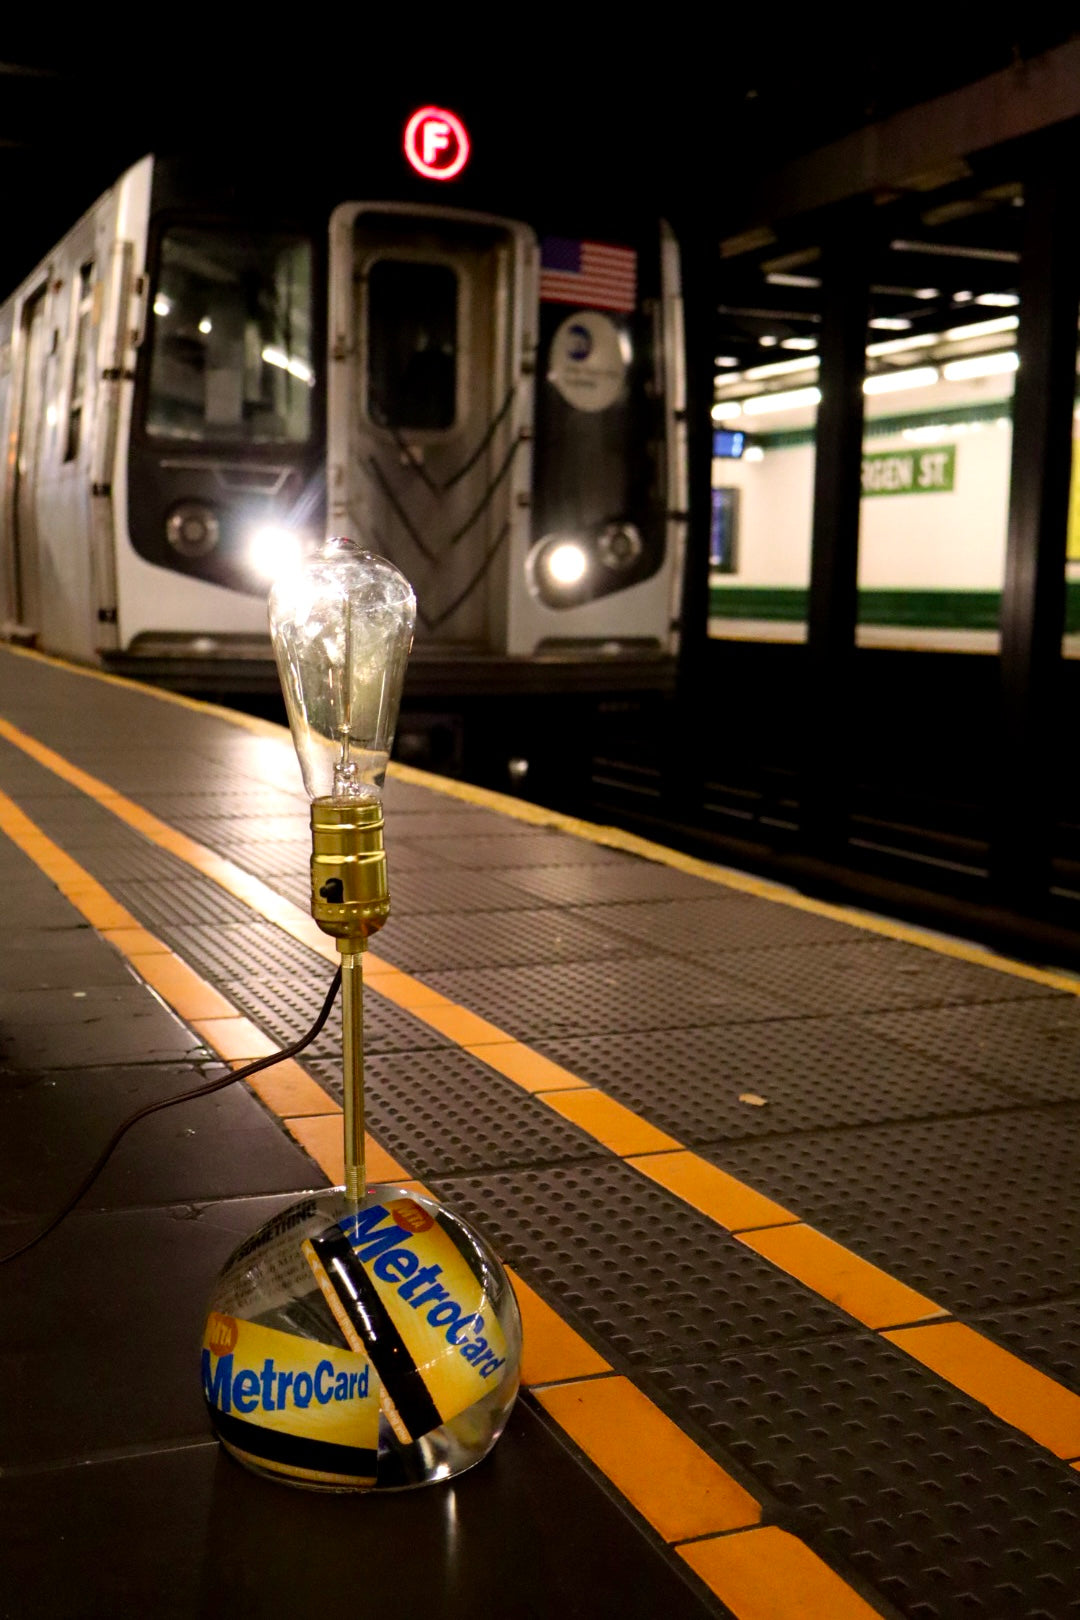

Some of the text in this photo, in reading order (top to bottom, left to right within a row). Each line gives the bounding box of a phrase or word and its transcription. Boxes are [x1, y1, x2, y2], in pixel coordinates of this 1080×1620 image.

[422, 120, 450, 164] F
[338, 1205, 507, 1378] MetroCard
[202, 1348, 369, 1413] MetroCard
